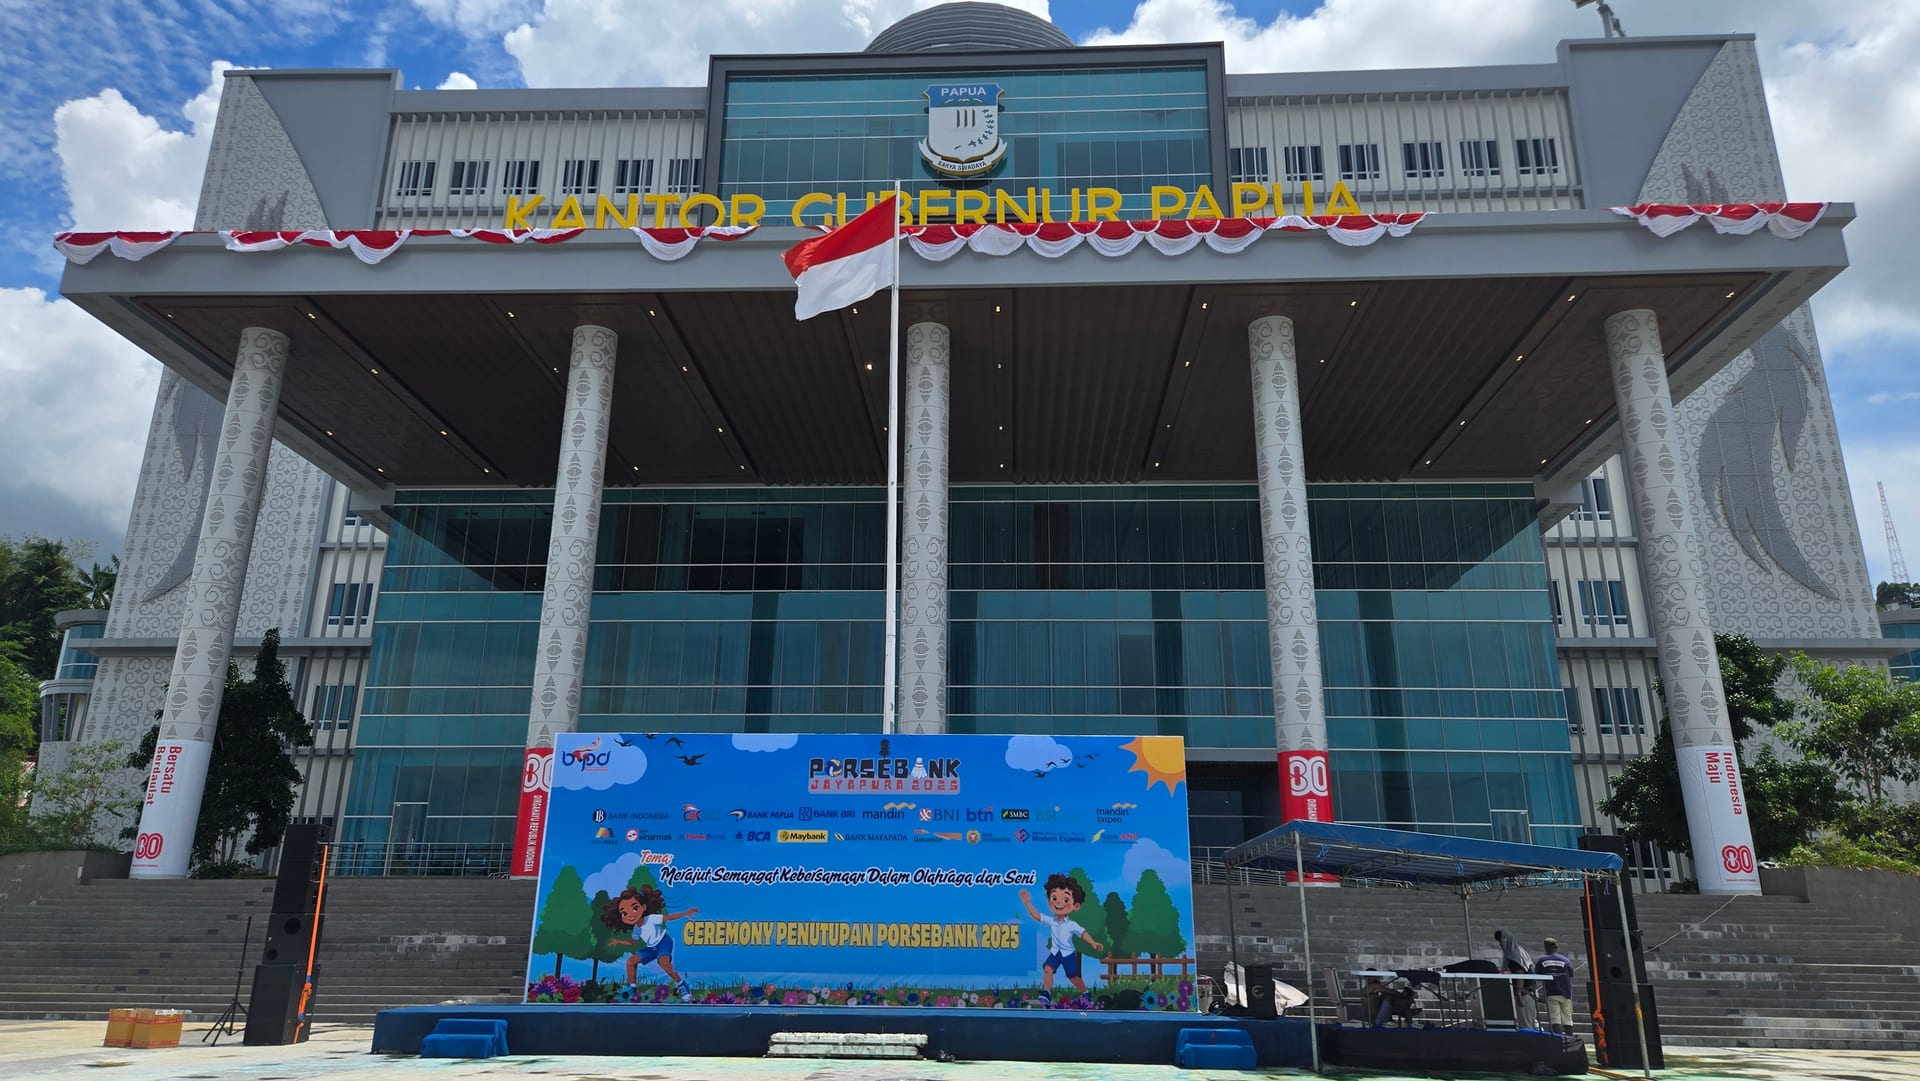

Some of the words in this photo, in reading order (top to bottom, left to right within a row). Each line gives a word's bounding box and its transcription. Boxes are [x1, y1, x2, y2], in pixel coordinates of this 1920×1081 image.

[941, 87, 987, 96] PAPUA
[505, 193, 767, 229] KANTOR
[1150, 181, 1361, 221] PAPUA
[160, 746, 182, 794] Bersatu
[1705, 752, 1722, 784] Maju
[145, 746, 166, 806] Berdaulat
[810, 779, 904, 791] JAYAPURA
[911, 779, 959, 791] 2025
[1723, 752, 1743, 815] Indonesia
[608, 812, 628, 820] BANK
[631, 812, 670, 820] INDONESIA
[747, 811, 769, 819] BANK
[770, 811, 794, 819] PAPUA
[814, 810, 840, 818] BANK
[841, 809, 856, 818] BRI
[862, 807, 905, 819] mandiri
[934, 809, 960, 821] BNI
[967, 807, 994, 822] btn
[747, 831, 771, 841] BCA
[790, 832, 826, 841] Maybank
[868, 833, 908, 841] MAYAPADA
[1721, 845, 1754, 874] 80
[660, 866, 711, 887] Merajut
[712, 867, 779, 885] Semangat
[780, 867, 866, 885] Kebersamaan
[867, 867, 910, 886] Dalam
[913, 868, 974, 887] Olahraga
[975, 869, 1001, 886] dan
[1003, 869, 1036, 885] Seni
[683, 920, 776, 947] CEREMONY
[776, 921, 874, 948] PENUTUPAN
[877, 922, 980, 949] PORSEBANK
[981, 923, 1020, 949] 2025
